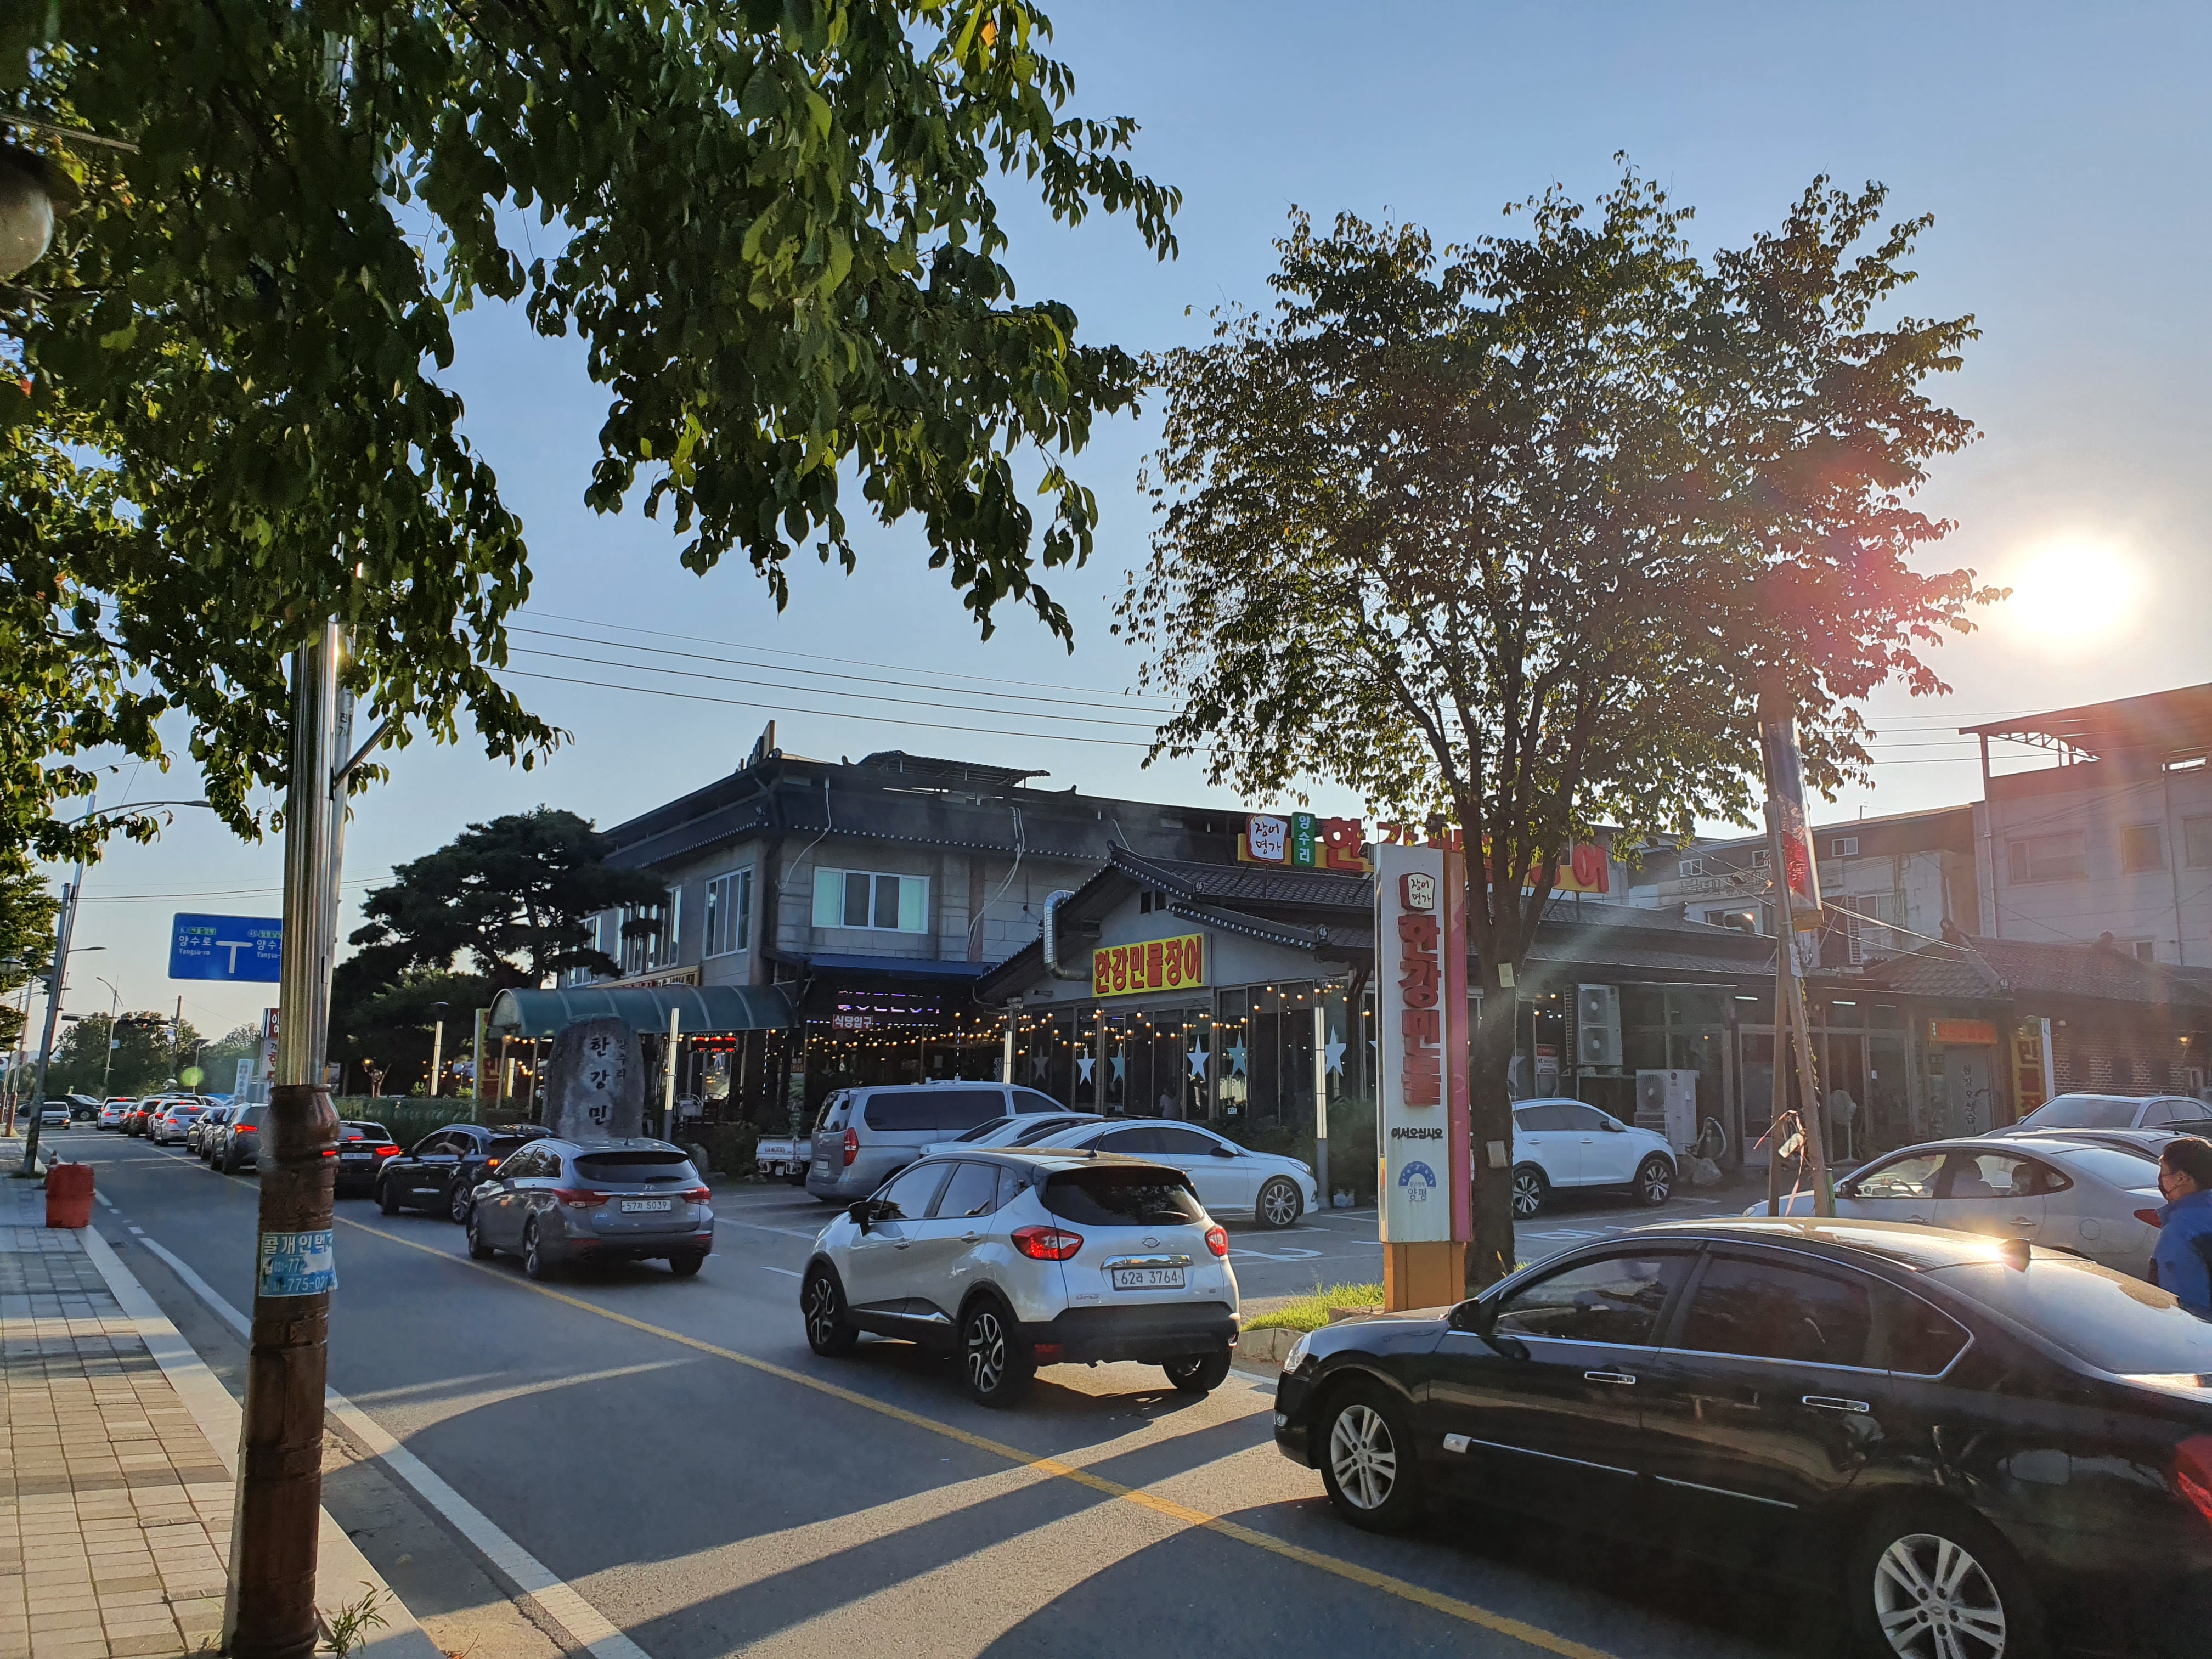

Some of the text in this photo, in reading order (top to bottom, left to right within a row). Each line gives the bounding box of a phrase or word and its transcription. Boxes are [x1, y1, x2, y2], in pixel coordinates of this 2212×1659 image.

[1255, 822, 1280, 834] 장어
[1298, 815, 1311, 862] 양수리
[1255, 840, 1282, 855] 명가
[1410, 878, 1429, 890] 장어
[1412, 893, 1431, 905] 명가
[178, 935, 212, 946] 양수로
[257, 939, 281, 950] 양수
[256, 951, 280, 960] Yangsu-
[1094, 935, 1202, 994] 한강민물장어
[1397, 914, 1442, 1105] 한강민물
[834, 1015, 872, 1029] 식당입구
[589, 1037, 611, 1125] 한강민
[1391, 1127, 1443, 1140] 어서오십시오
[1408, 1188, 1426, 1200] 양평
[647, 1201, 667, 1210] 5039
[1149, 1269, 1178, 1284] 3764
